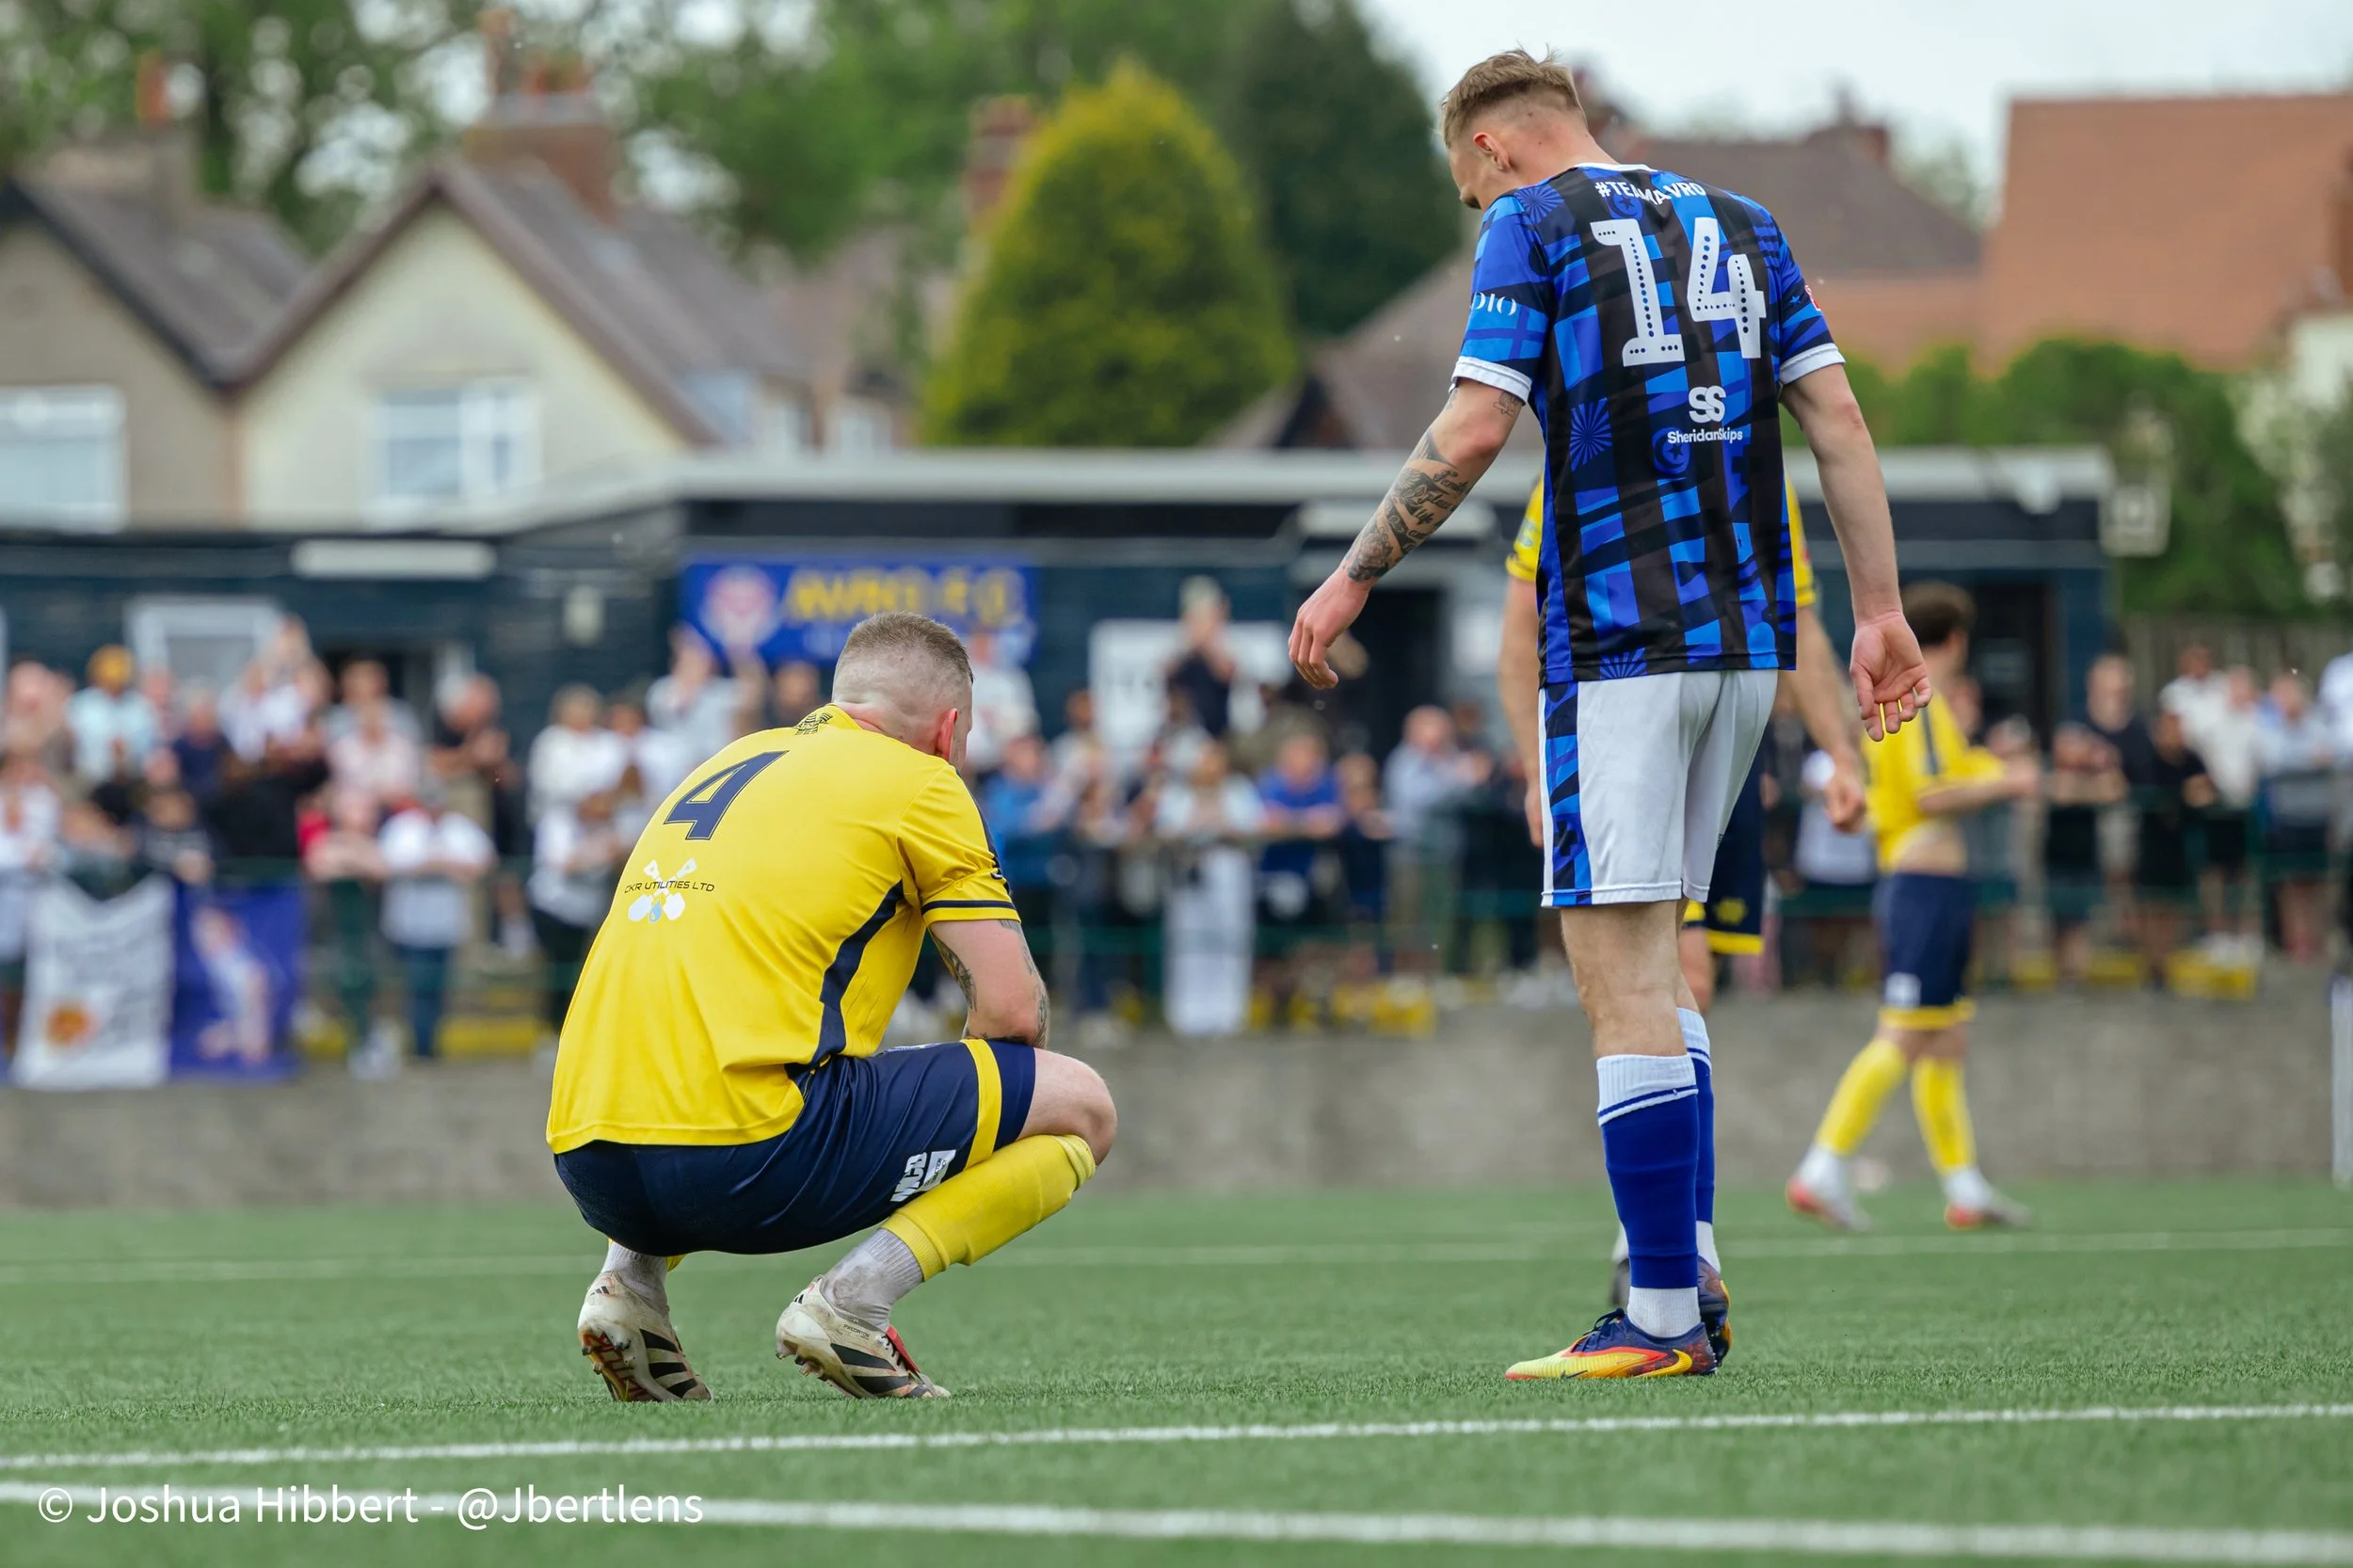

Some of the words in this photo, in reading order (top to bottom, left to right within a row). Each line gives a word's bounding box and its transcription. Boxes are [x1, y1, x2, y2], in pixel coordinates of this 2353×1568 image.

[1590, 216, 1767, 367] 14
[663, 750, 791, 840] 4
[645, 880, 690, 890] UTILITIES
[692, 882, 715, 892] LTD
